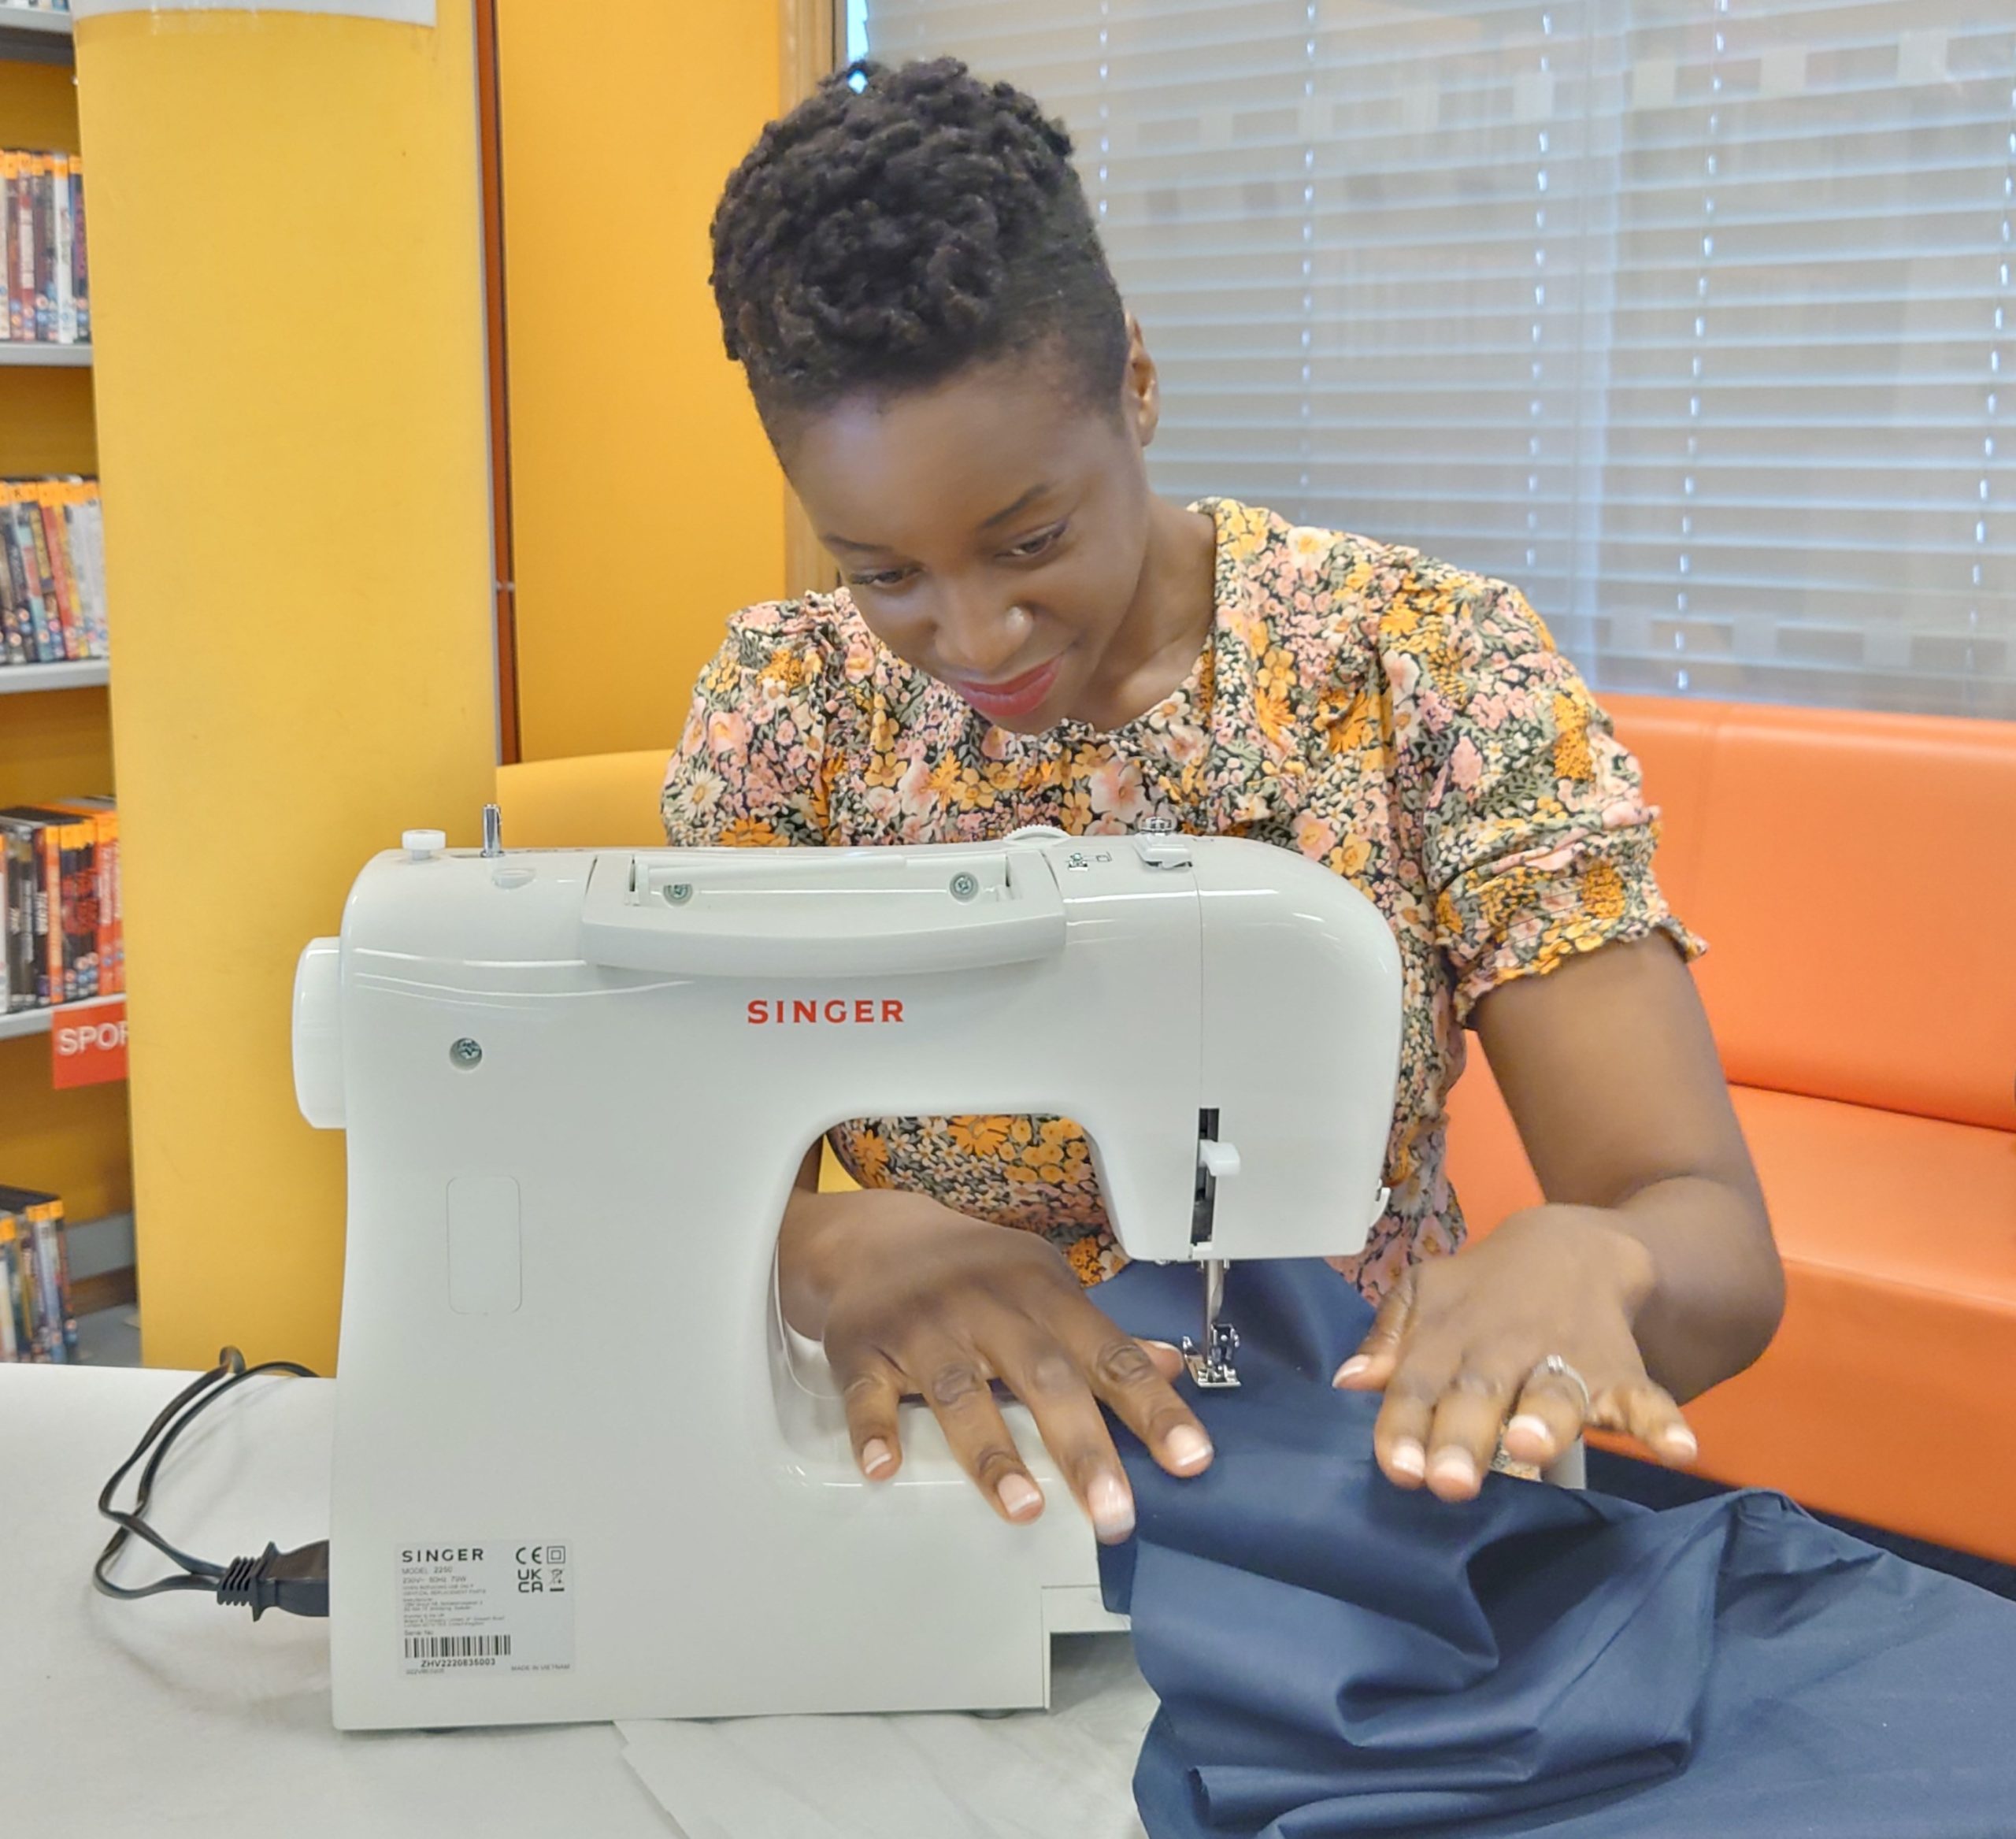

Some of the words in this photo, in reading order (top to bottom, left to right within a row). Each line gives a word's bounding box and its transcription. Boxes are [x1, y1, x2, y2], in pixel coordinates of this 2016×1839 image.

[747, 999, 904, 1024] SINGER
[402, 1548, 484, 1563] SINGER
[516, 1547, 542, 1565] CE
[517, 1568, 542, 1580] UK
[518, 1581, 543, 1592] CA
